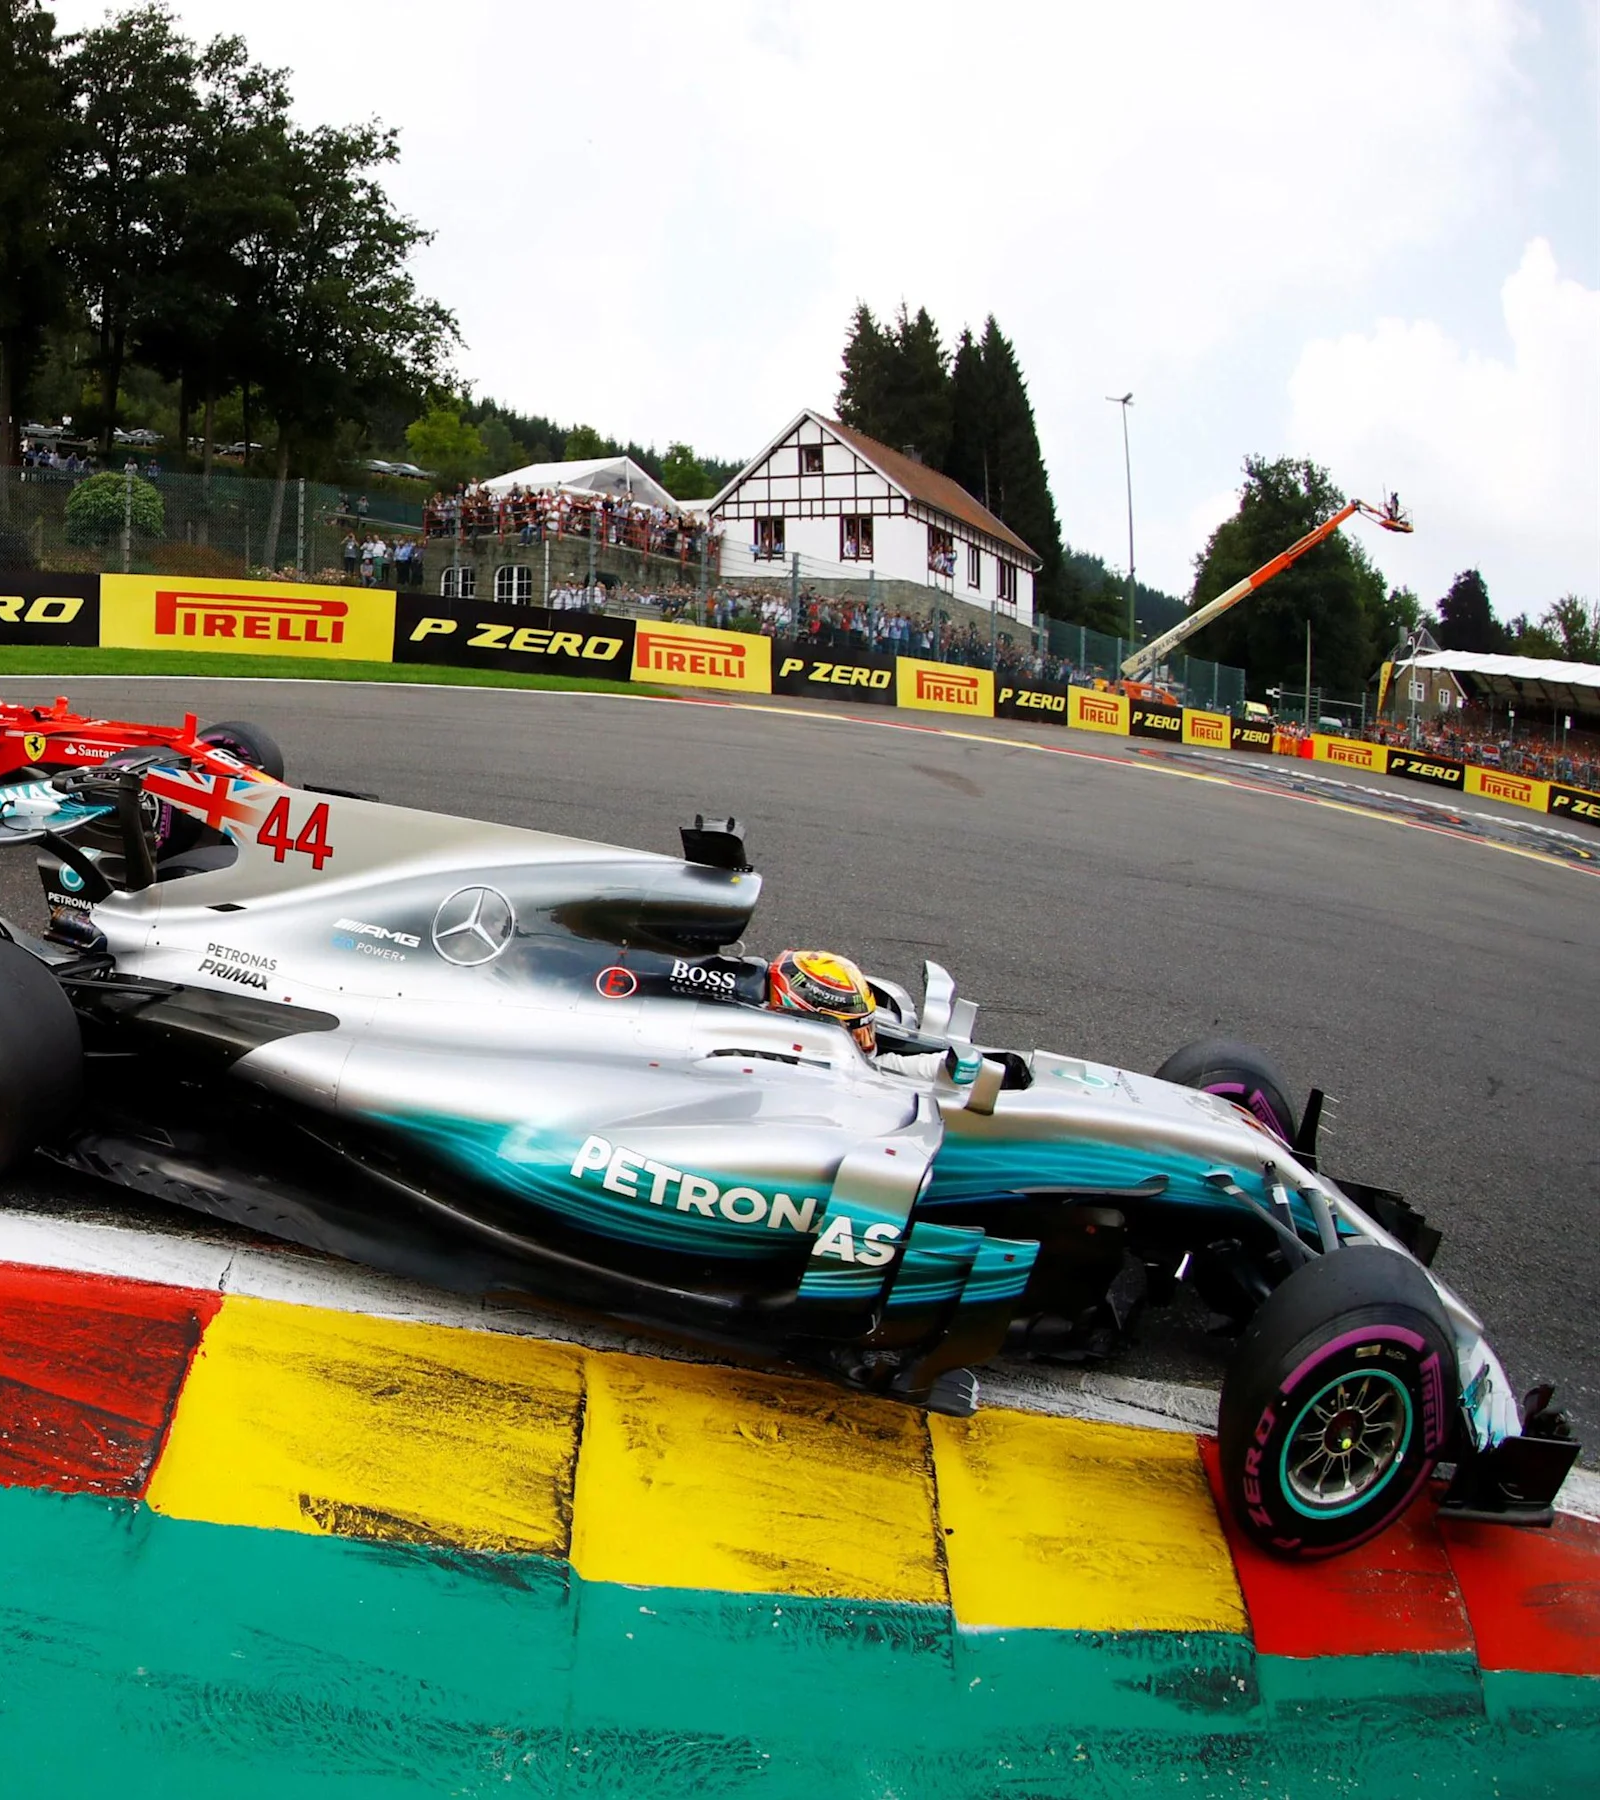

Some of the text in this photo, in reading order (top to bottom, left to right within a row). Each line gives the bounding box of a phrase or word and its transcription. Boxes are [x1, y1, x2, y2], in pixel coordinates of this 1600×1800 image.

[155, 590, 349, 644] PIRELLI
[409, 618, 623, 661] P ZERO
[636, 631, 746, 679] PIRELLI
[779, 658, 892, 690] P ZERO
[917, 670, 979, 706] PIRELLI
[999, 687, 1066, 713] P ZERO
[1079, 696, 1120, 726] PIRELLI
[1132, 711, 1181, 731] P ZERO
[1191, 716, 1223, 741] PIRELLI
[1232, 728, 1271, 744] P ZERO
[1327, 743, 1373, 767] PIRELLI
[1390, 758, 1460, 782] P ZERO
[1480, 774, 1532, 803] PIRELLI
[1552, 795, 1570, 808] P
[257, 796, 334, 871] 44
[357, 922, 422, 948] AMG
[206, 942, 278, 972] PETRONAS
[198, 959, 270, 991] PRIMAX
[604, 968, 629, 996] E
[671, 959, 736, 989] BOSS
[805, 982, 847, 1004] MONSTER
[570, 1134, 903, 1268] PETRONAS
[1419, 1351, 1444, 1453] PIRELLI
[1243, 1405, 1277, 1528] ZERO
